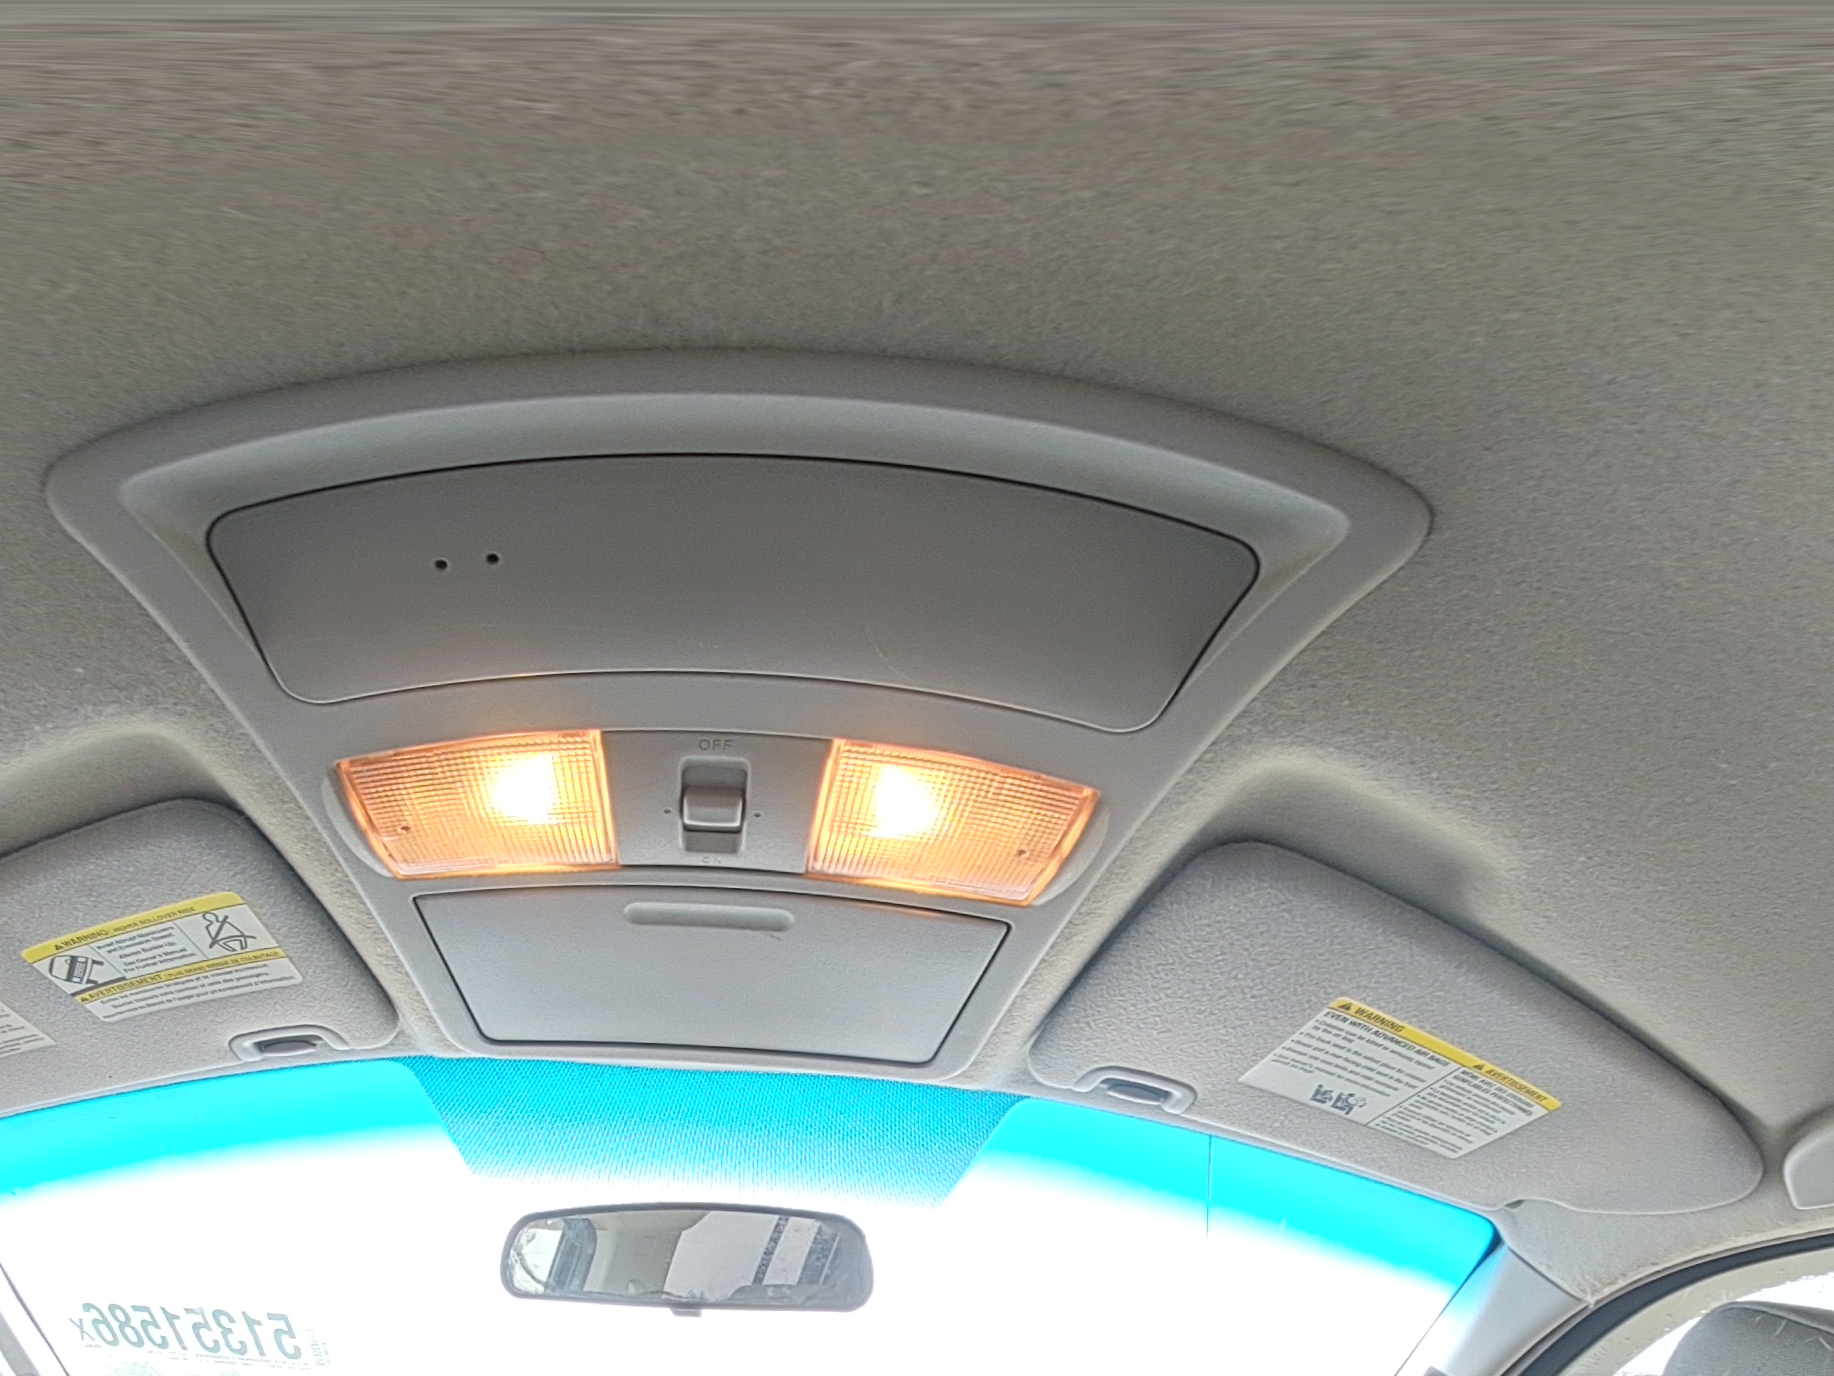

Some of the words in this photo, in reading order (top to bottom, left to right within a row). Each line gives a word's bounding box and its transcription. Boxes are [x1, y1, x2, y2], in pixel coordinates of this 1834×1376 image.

[698, 739, 733, 750] OFF
[140, 912, 176, 926] ROLLOVER
[89, 974, 162, 999] AVERTISSEMENT
[1324, 1011, 1349, 1023] EVEN
[1349, 1020, 1372, 1033] WITH
[1372, 1029, 1416, 1051] ADVANCED
[1355, 1007, 1405, 1033] WARNING
[1485, 1069, 1549, 1102] AVERTISSEMENT
